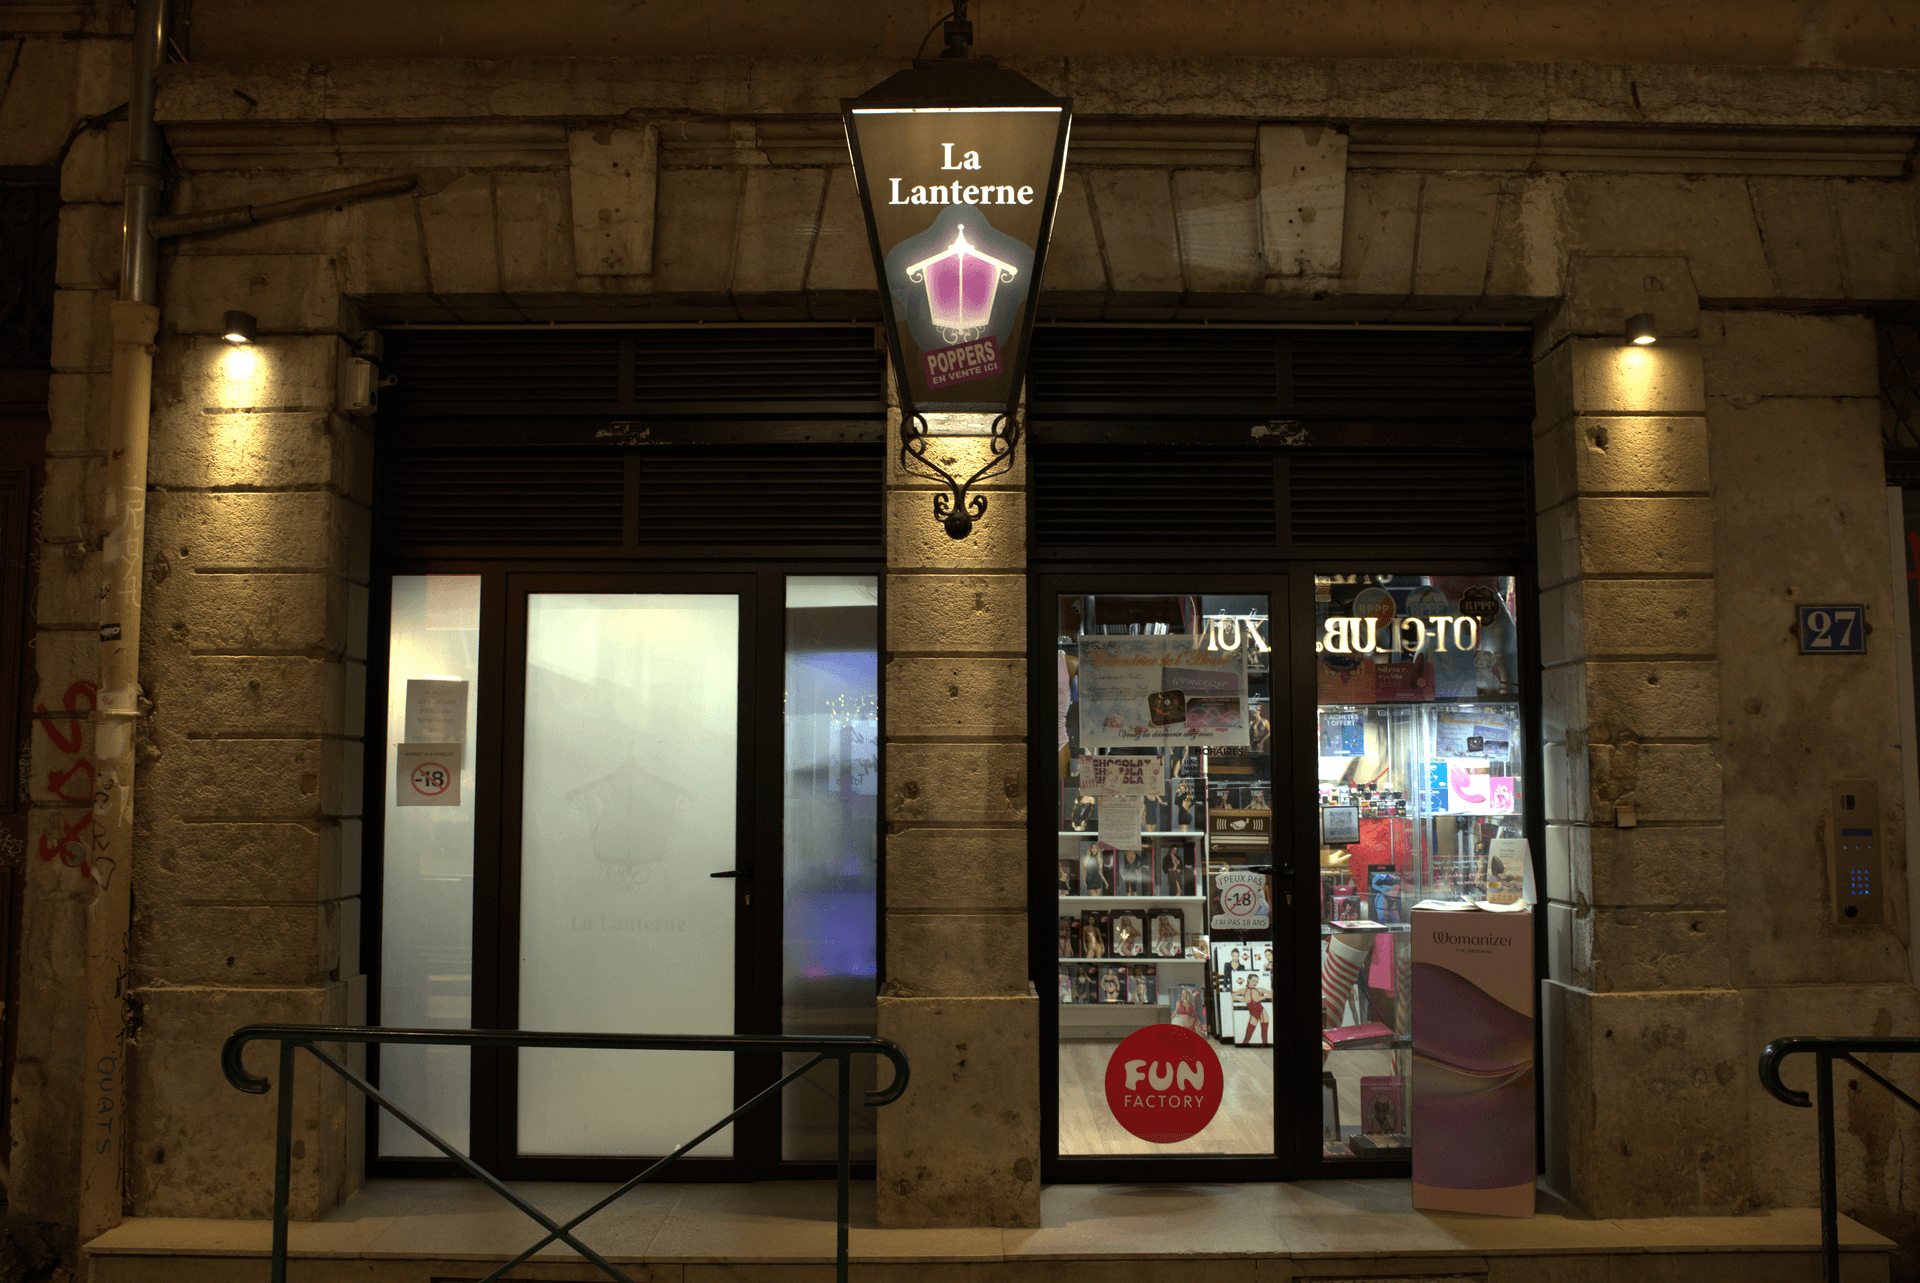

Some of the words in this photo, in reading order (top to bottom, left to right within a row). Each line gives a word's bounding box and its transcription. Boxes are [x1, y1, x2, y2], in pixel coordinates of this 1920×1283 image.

[941, 143, 982, 171] La
[889, 178, 1034, 206] Lanterne
[927, 340, 996, 376] POPPERS
[932, 375, 946, 386] EN
[948, 367, 982, 382] VENTE
[984, 362, 998, 373] ICI
[1465, 601, 1495, 611] RPPP
[1807, 610, 1857, 648] 27
[1118, 728, 1141, 742] Venez
[1195, 747, 1244, 757] HORAIRES
[415, 771, 444, 787] -18
[1218, 873, 1246, 885] J'PEUX
[1248, 875, 1263, 886] PAS
[1227, 892, 1251, 907] -18
[570, 915, 593, 932] La
[600, 914, 687, 932] Lanterne
[1433, 931, 1512, 947] Womanizer
[1124, 1059, 1204, 1091] FUN
[96, 1056, 116, 1156] OUATS
[1124, 1095, 1204, 1108] FACTORY
